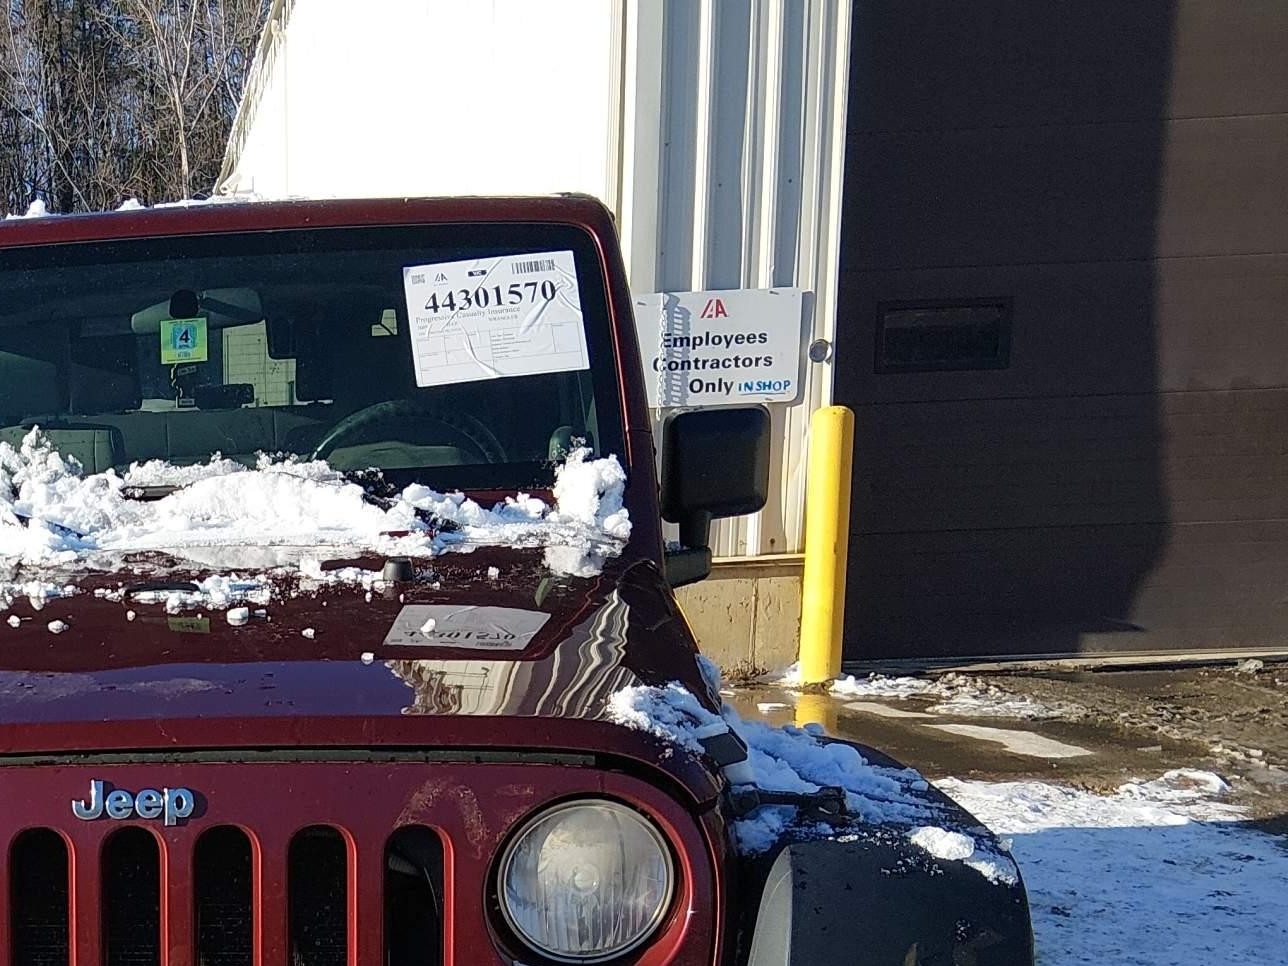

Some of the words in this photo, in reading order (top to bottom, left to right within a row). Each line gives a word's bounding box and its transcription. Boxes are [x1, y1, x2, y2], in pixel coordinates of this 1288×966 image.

[425, 280, 556, 313] 44301570
[416, 314, 455, 323] Progressiv
[179, 328, 191, 343] 4
[663, 331, 768, 350] Employees
[653, 355, 773, 372] Contractors
[689, 378, 734, 396] Only
[755, 380, 791, 392] SHOP
[71, 779, 194, 826] Jeep
